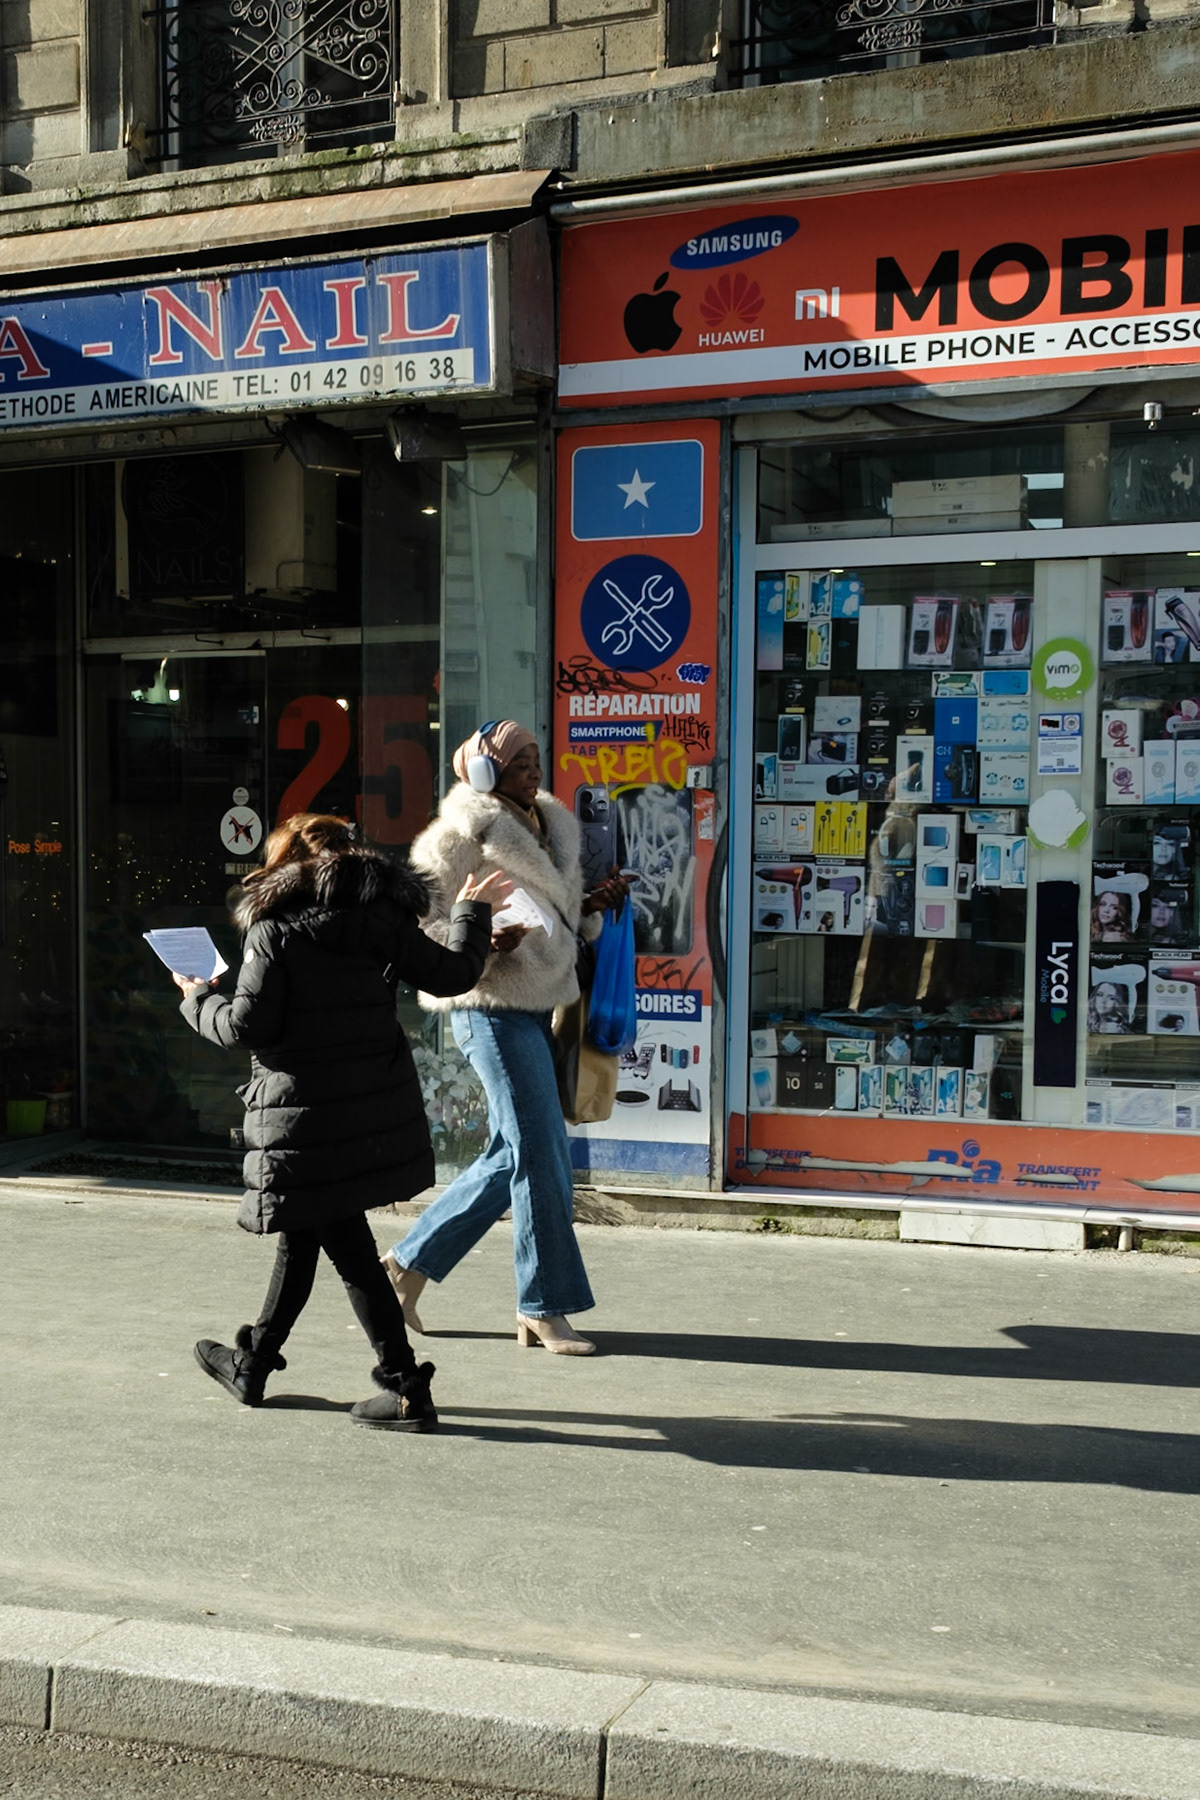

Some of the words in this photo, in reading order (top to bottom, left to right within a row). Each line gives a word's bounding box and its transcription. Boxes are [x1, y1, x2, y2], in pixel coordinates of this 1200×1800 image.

[686, 230, 783, 256] SAMSUNG
[145, 270, 460, 366] NAIL
[699, 328, 765, 347] HUAWEI
[804, 341, 916, 372] MOBILE
[927, 331, 1035, 361] PHONE
[90, 379, 218, 411] AMERICAINE
[233, 376, 278, 397] TEL:
[290, 372, 311, 393] 01
[323, 369, 347, 389] 42
[360, 366, 383, 386] 09
[395, 361, 416, 382] 16
[429, 356, 454, 379] 38
[569, 690, 700, 717] RÉPARATION
[8, 840, 31, 855] Pose
[34, 839, 63, 856] Simple
[1093, 861, 1125, 869] Techwood
[1090, 952, 1123, 960] Techwood
[1047, 942, 1073, 1003] Lyca
[1041, 969, 1049, 1003] Mobile
[786, 1077, 801, 1090] 10
